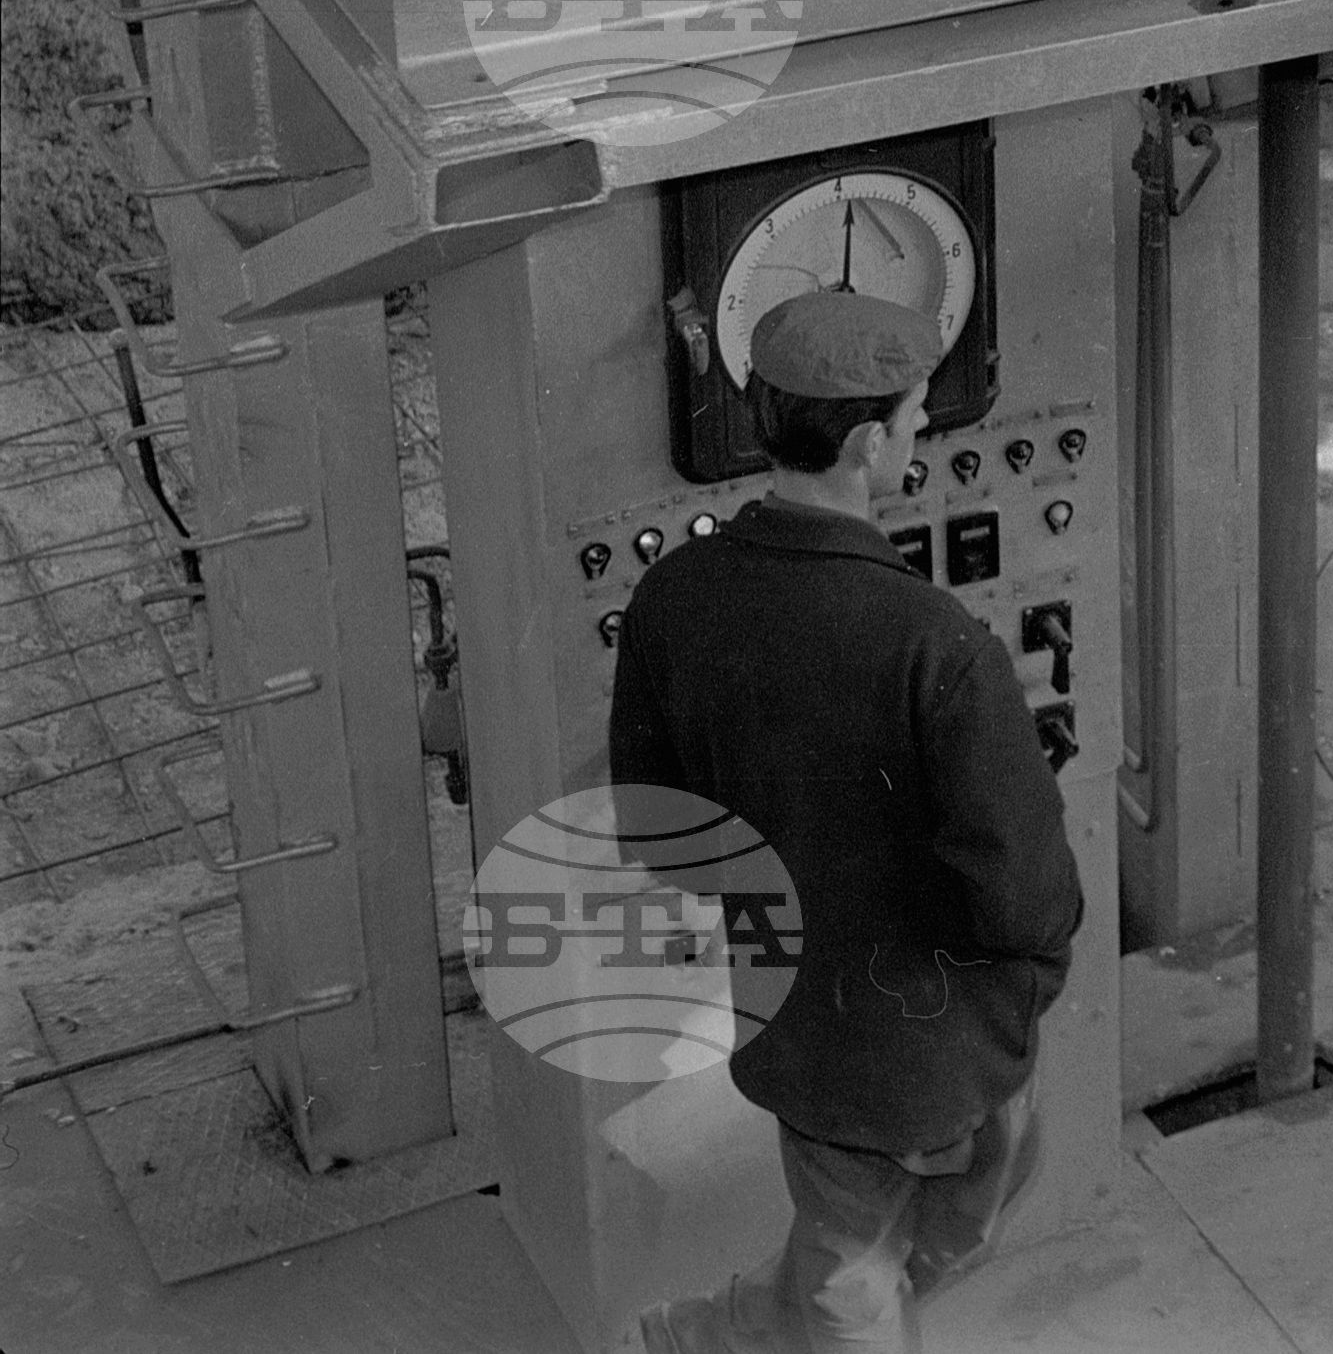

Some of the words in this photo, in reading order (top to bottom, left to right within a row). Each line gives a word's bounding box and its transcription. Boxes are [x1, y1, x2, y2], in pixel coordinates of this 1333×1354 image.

[833, 178, 843, 193] 4
[906, 184, 917, 200] 5
[764, 219, 775, 234] 3
[951, 242, 962, 258] 6
[727, 295, 737, 311] 2
[945, 316, 954, 330] 7
